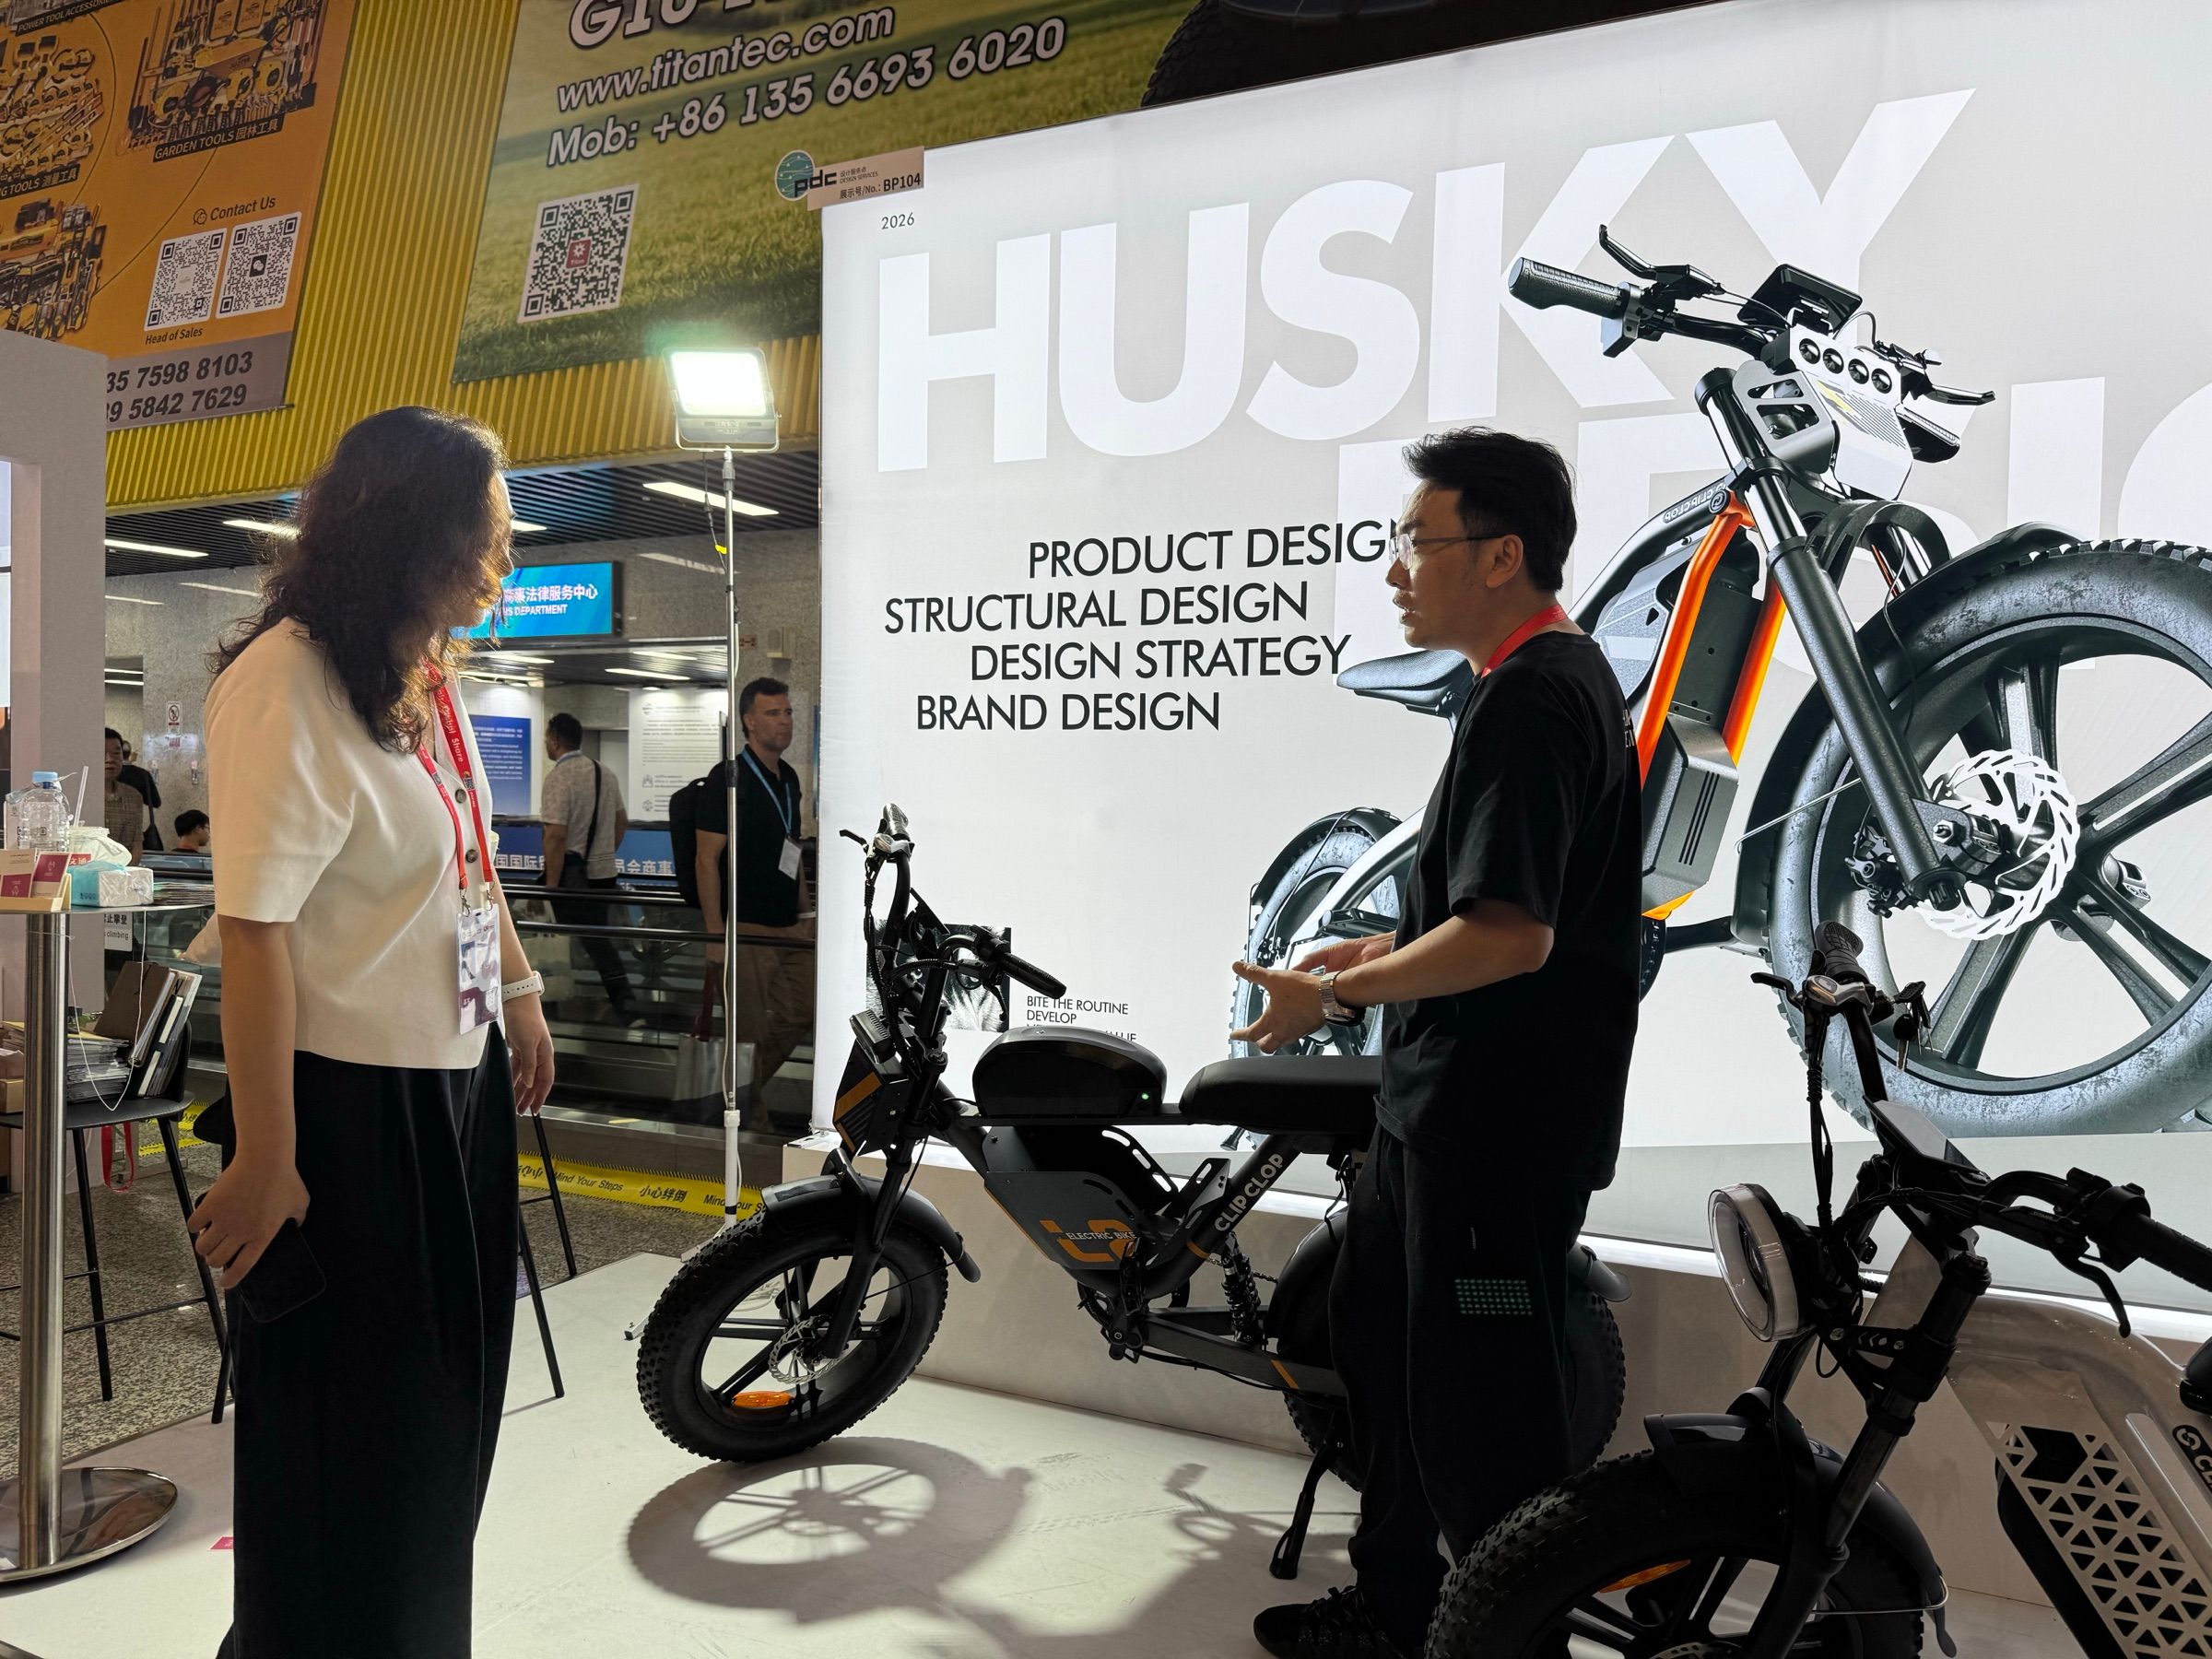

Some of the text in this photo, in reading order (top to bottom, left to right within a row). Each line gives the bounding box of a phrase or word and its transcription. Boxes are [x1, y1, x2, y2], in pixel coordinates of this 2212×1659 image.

[557, 6, 894, 112] www.titantec.com
[547, 17, 1066, 167] Mob: +86 135 6693 6020
[155, 140, 197, 159] GARDEN
[199, 132, 234, 150] TOOLS
[883, 172, 922, 192] BP104
[210, 195, 276, 221] Contact Us
[881, 212, 915, 229] 2026
[877, 88, 1977, 474] HUSKY
[145, 327, 203, 345] Head of Sales
[136, 361, 190, 389] 7598
[195, 351, 253, 379] 8103
[129, 393, 183, 419] 5842
[191, 383, 247, 412] 7629
[1029, 518, 1396, 579] PRODUCT DESIG
[885, 581, 1308, 634] STRUCTURAL DESIGN
[971, 634, 1352, 681] DESIGN STRATEGY
[916, 691, 1220, 731] BRAND DESIGN
[1027, 995, 1129, 1015] BITE THE ROUTINE
[1027, 1010, 1077, 1024] DEVELOP
[554, 1171, 624, 1192] Mind Your Steps
[1065, 1231, 1137, 1241] ELECTRIC BIKE
